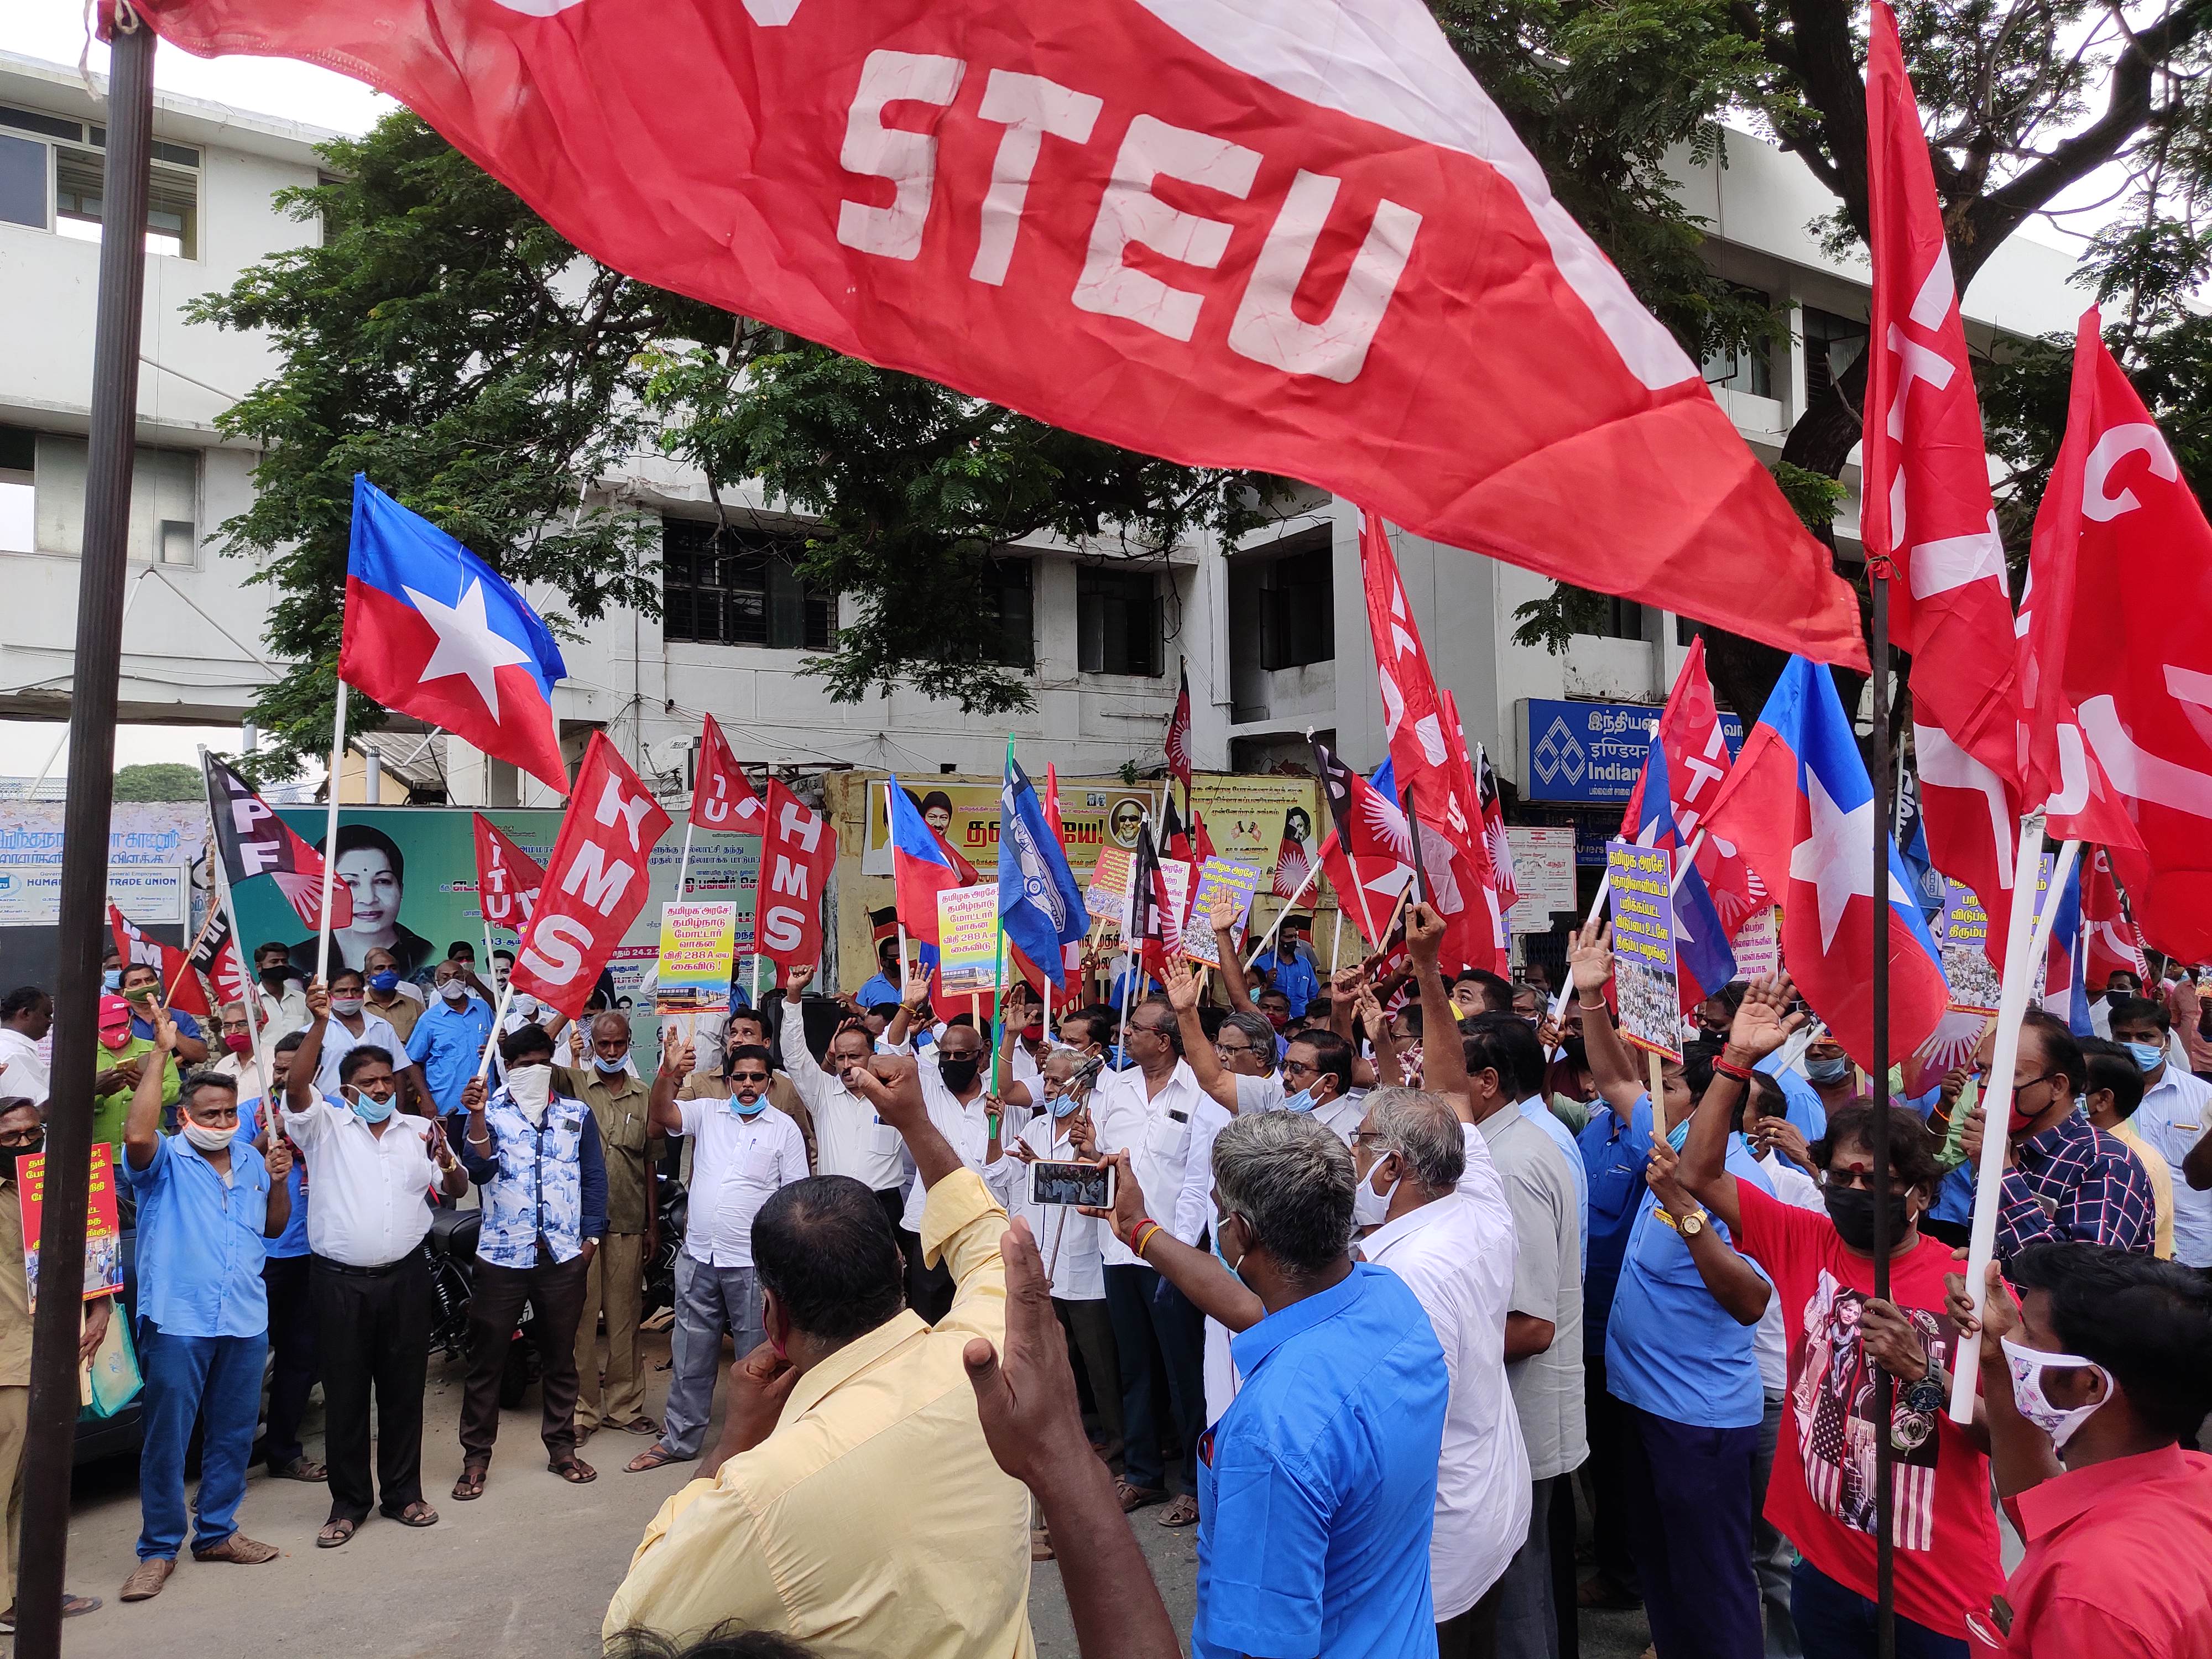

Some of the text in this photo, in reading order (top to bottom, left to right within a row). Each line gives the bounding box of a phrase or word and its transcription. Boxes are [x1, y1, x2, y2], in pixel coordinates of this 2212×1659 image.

[836, 49, 1423, 383] STEU
[1588, 762, 1641, 781] Indian
[652, 844, 679, 855] ளுக்கு
[723, 845, 744, 855] தந்து
[675, 855, 728, 865] மநிலமாக்க
[1609, 848, 1666, 877] தமிழக அரசே!
[519, 769, 653, 985] HMS
[764, 801, 822, 951] HMS
[1206, 860, 1257, 881] தமிழக அரசே!
[1203, 872, 1253, 891] தொழிலாளியிடம்
[1610, 873, 1668, 898] தொழிலாளியிடம்
[942, 886, 999, 905] தமிழக அரசே!
[667, 905, 732, 917] தமிழக அரசே!
[947, 899, 995, 915] தமிழ்நாடு
[1619, 896, 1661, 918] பறிக்கப்பட்ட
[672, 917, 726, 929] தமிழ்நாடு
[950, 910, 993, 923] மோட்டார்
[674, 929, 723, 938] மோட்டார்
[956, 921, 989, 932] வாகன
[1615, 914, 1668, 941] விடுப்பை உடனே
[1745, 921, 1765, 933] பெற்ற
[943, 934, 959, 945] விதி
[1616, 933, 1639, 953] திரும்ப
[664, 951, 682, 962] விதி
[1736, 965, 1767, 977] னடியாக
